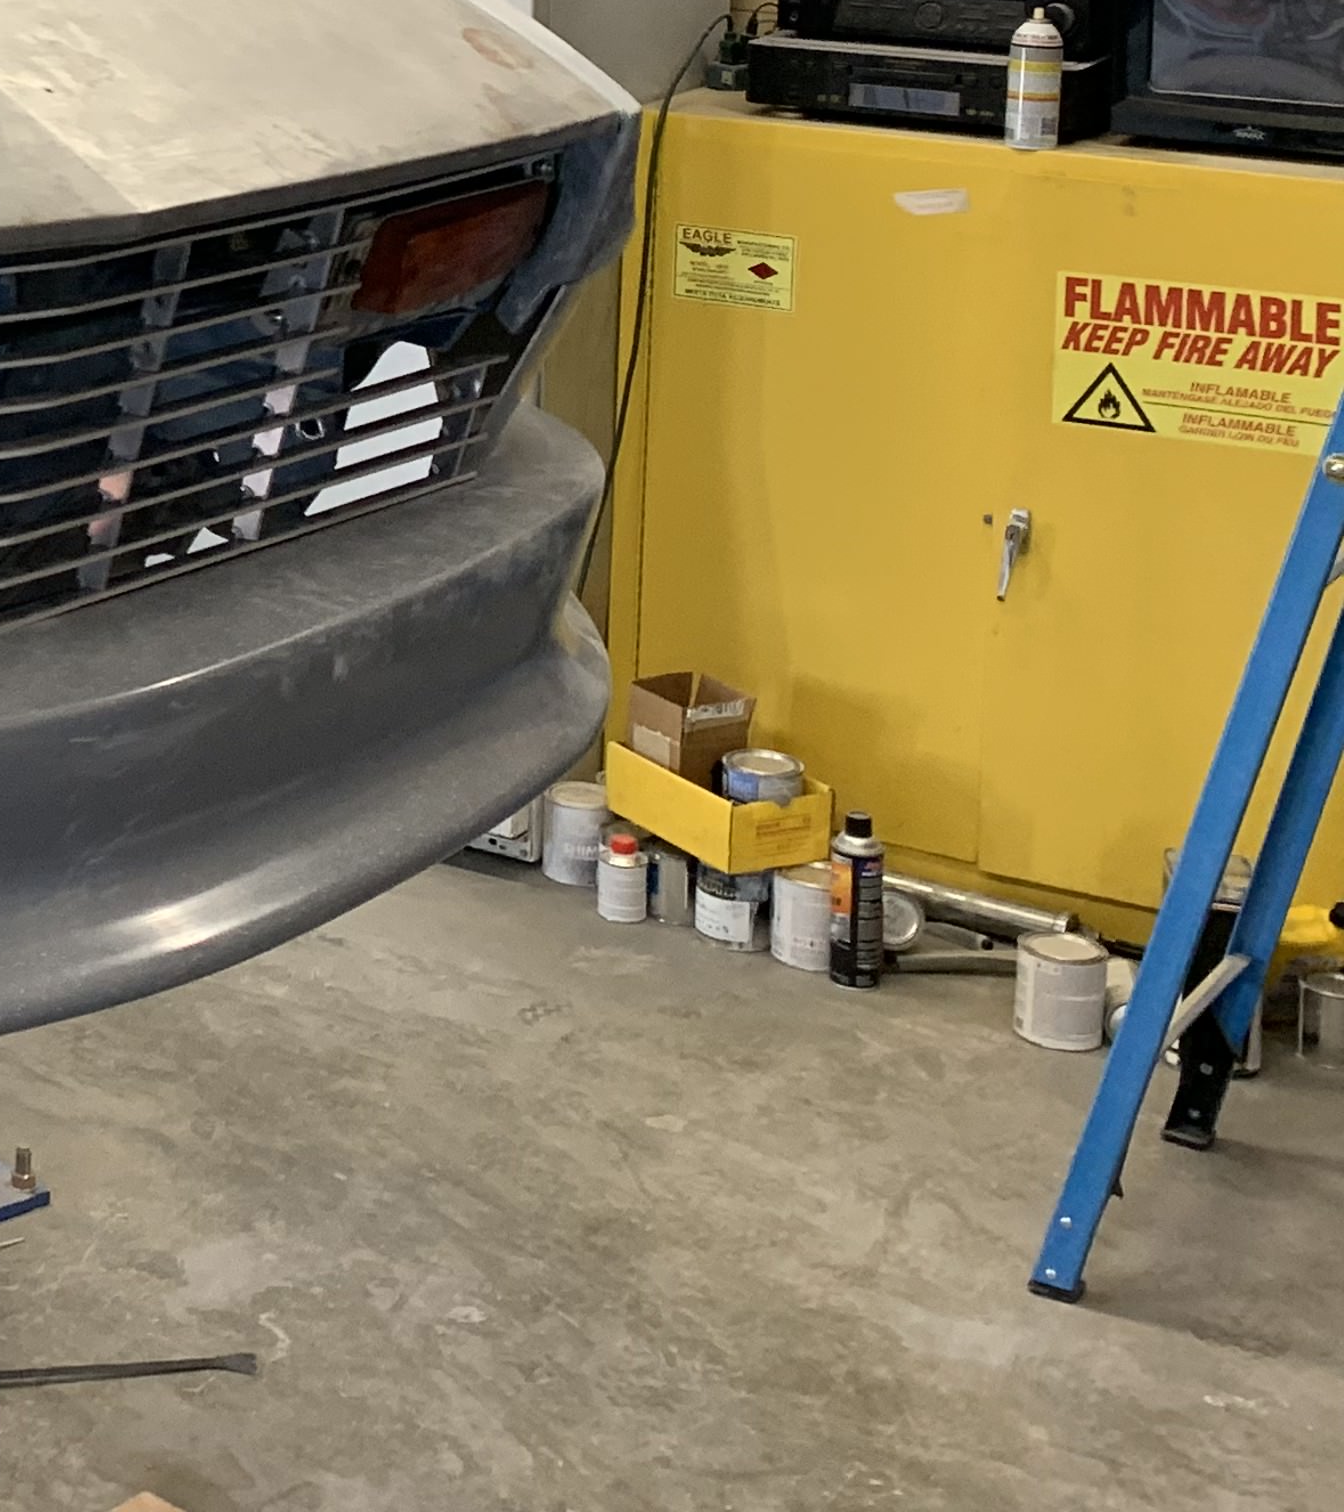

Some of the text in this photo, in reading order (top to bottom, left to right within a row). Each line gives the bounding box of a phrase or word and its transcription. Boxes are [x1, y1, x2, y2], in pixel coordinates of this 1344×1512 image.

[682, 227, 732, 244] EAGLE
[1063, 276, 1341, 346] FLAMMABLE
[1061, 321, 1341, 379] KEEP FIRE AWAY
[1189, 382, 1292, 404] INFLAMABLE
[1300, 407, 1336, 419] FUEG
[1182, 413, 1298, 437] INFLAMMABLE
